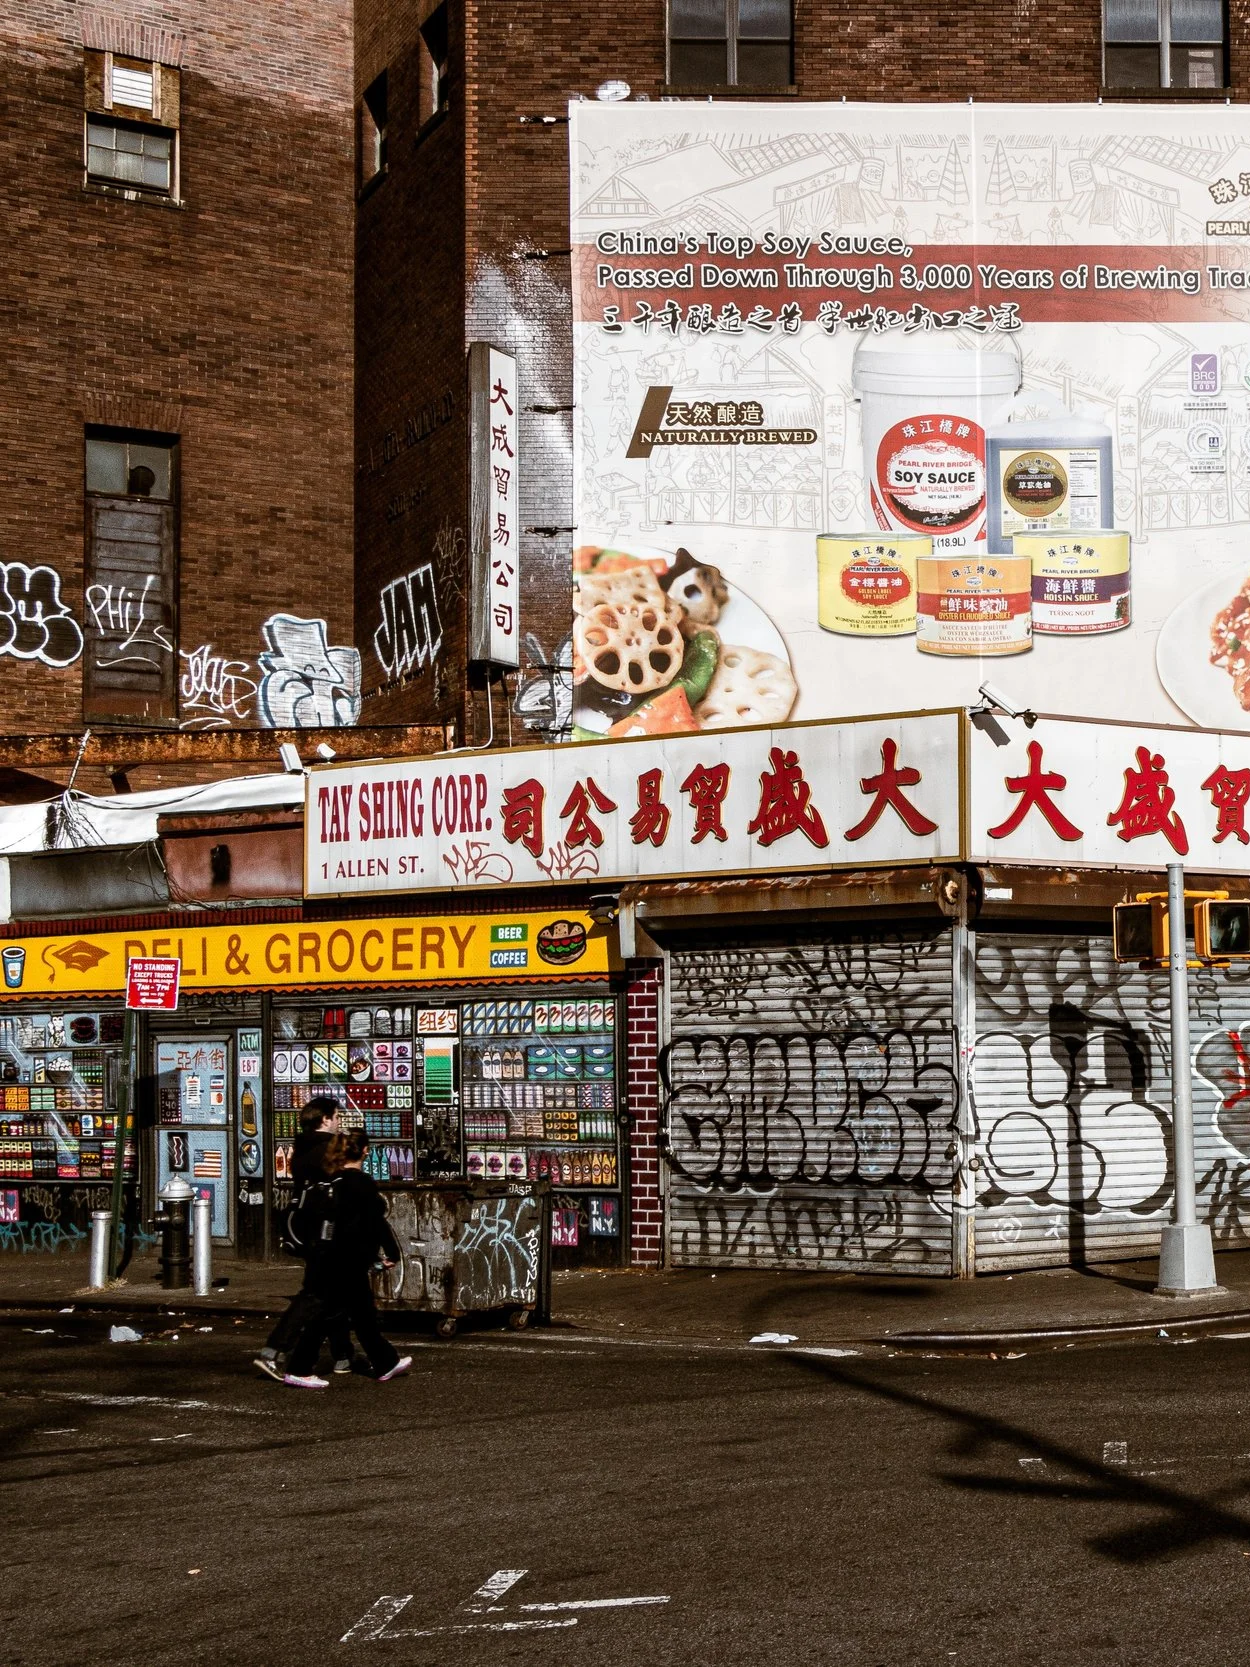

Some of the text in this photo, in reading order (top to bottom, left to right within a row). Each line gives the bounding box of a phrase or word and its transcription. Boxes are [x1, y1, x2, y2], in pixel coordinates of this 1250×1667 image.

[1207, 222, 1247, 236] PEARL
[596, 232, 914, 257] China's Top Soy Sauce,
[597, 265, 693, 289] Passed
[703, 265, 777, 288] Down
[786, 264, 893, 292] Through
[900, 265, 972, 292] 3,000
[978, 266, 1054, 290] Years
[1060, 265, 1089, 290] of
[1095, 265, 1200, 294] Brewing
[1193, 371, 1216, 380] BRC
[901, 418, 971, 439] 珠江橋牌
[640, 431, 816, 443] NATURALLY BREWED
[898, 460, 973, 468] PEARL RIVER BRIDGE
[894, 470, 976, 484] SOY SAUCE
[490, 377, 515, 636] 大成貿易公司
[936, 537, 966, 548] (18.9L)
[1043, 593, 1099, 602] HOISIN SAUCE
[938, 612, 959, 620] OYSTER
[995, 612, 1011, 620] SAUCE
[318, 773, 493, 843] TAY SHING CORP.
[321, 863, 329, 879] 1
[335, 858, 389, 879] ALLEN
[398, 855, 424, 874] ST.
[497, 927, 522, 940] BEER
[225, 934, 251, 976] &
[265, 925, 477, 976] GROCERY
[491, 951, 527, 966] COFFEE
[144, 963, 176, 971] STANDING
[136, 983, 150, 991] 7AM
[419, 1010, 458, 1032] 纽约
[240, 1034, 259, 1049] ATM
[242, 1059, 257, 1073] EBT
[165, 1101, 177, 1110] 40
[591, 1200, 600, 1215] I
[592, 1217, 617, 1234] N.Y.
[552, 1228, 577, 1243] N.Y.
